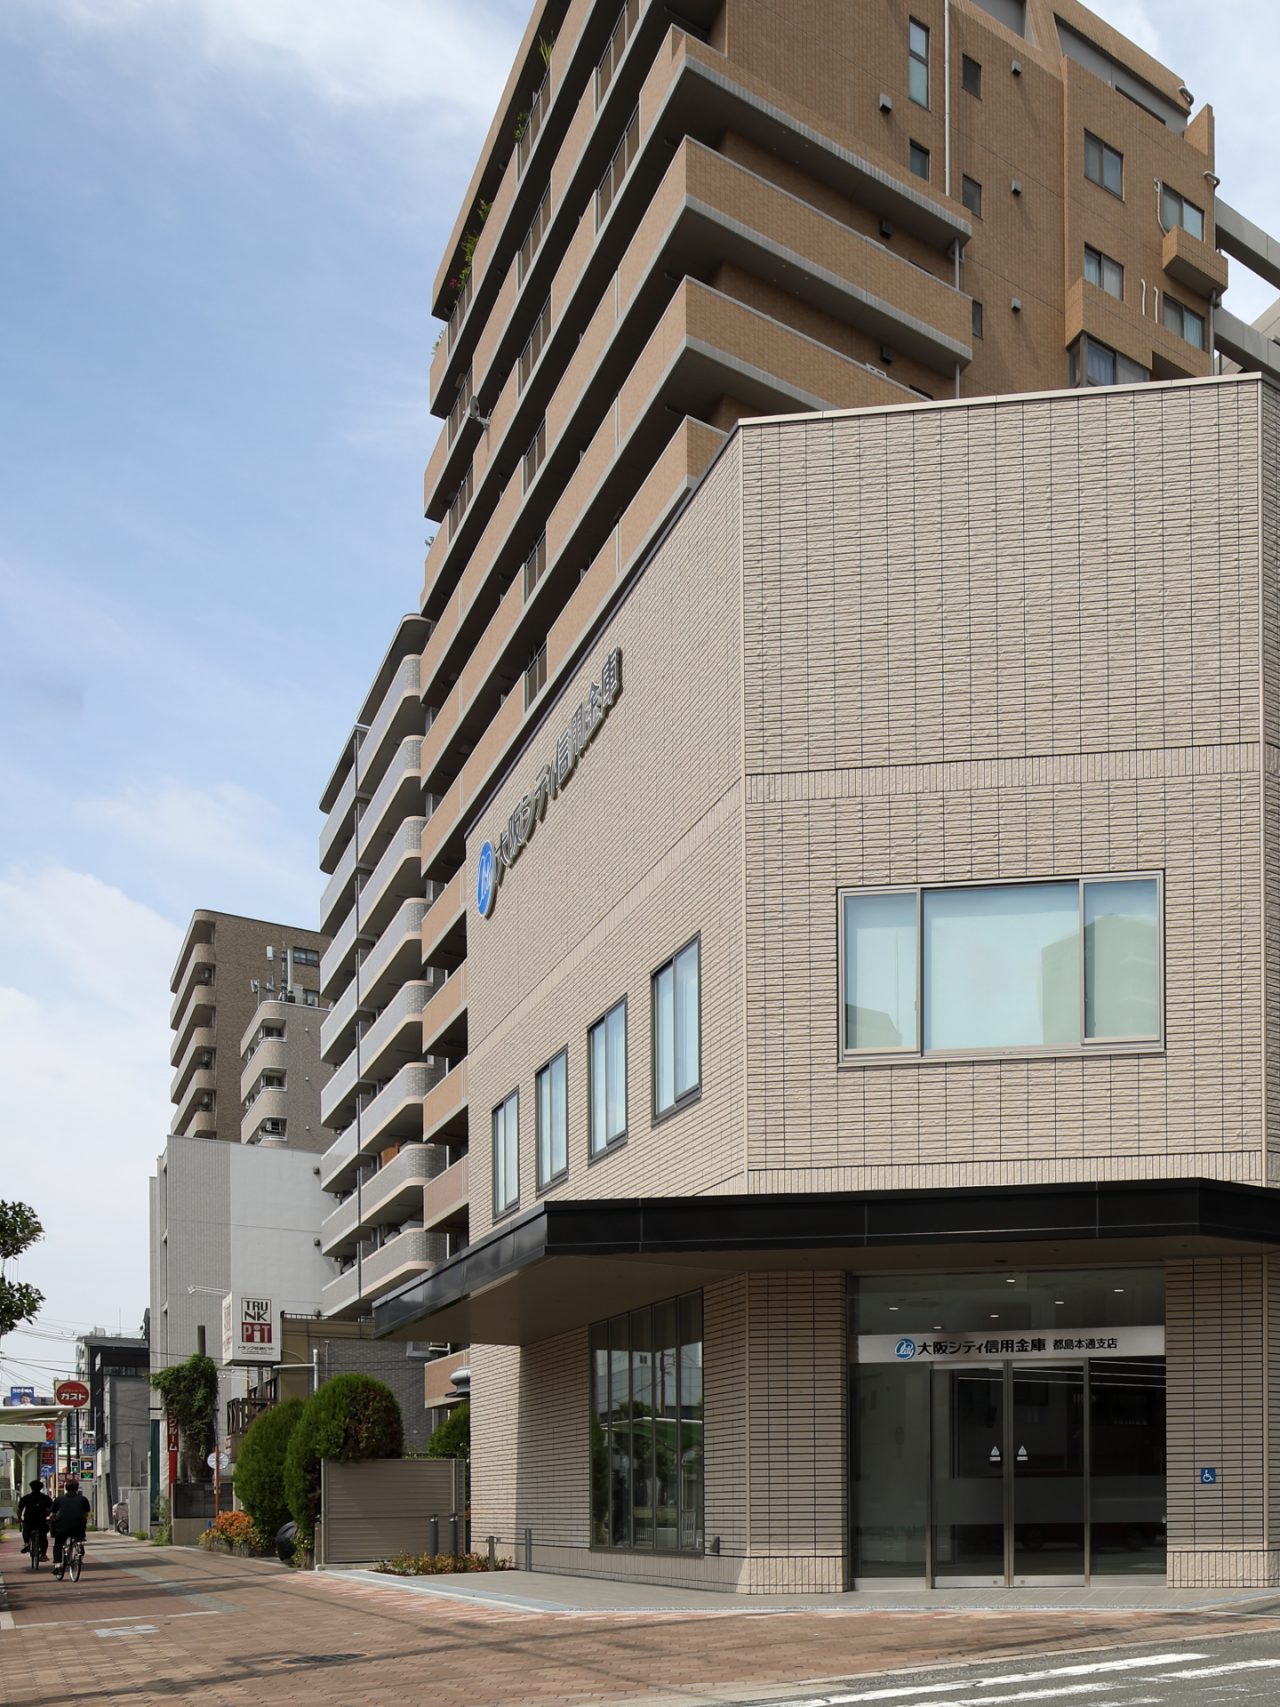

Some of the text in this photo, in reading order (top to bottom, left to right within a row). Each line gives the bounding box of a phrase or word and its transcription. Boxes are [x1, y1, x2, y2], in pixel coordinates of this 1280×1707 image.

[244, 1300, 269, 1312] TRU
[244, 1311, 268, 1322] NK
[917, 1338, 1118, 1356] 大阪シティ信用金庫 都島本通支店
[60, 1393, 86, 1401] ガスト
[83, 1461, 92, 1470] P
